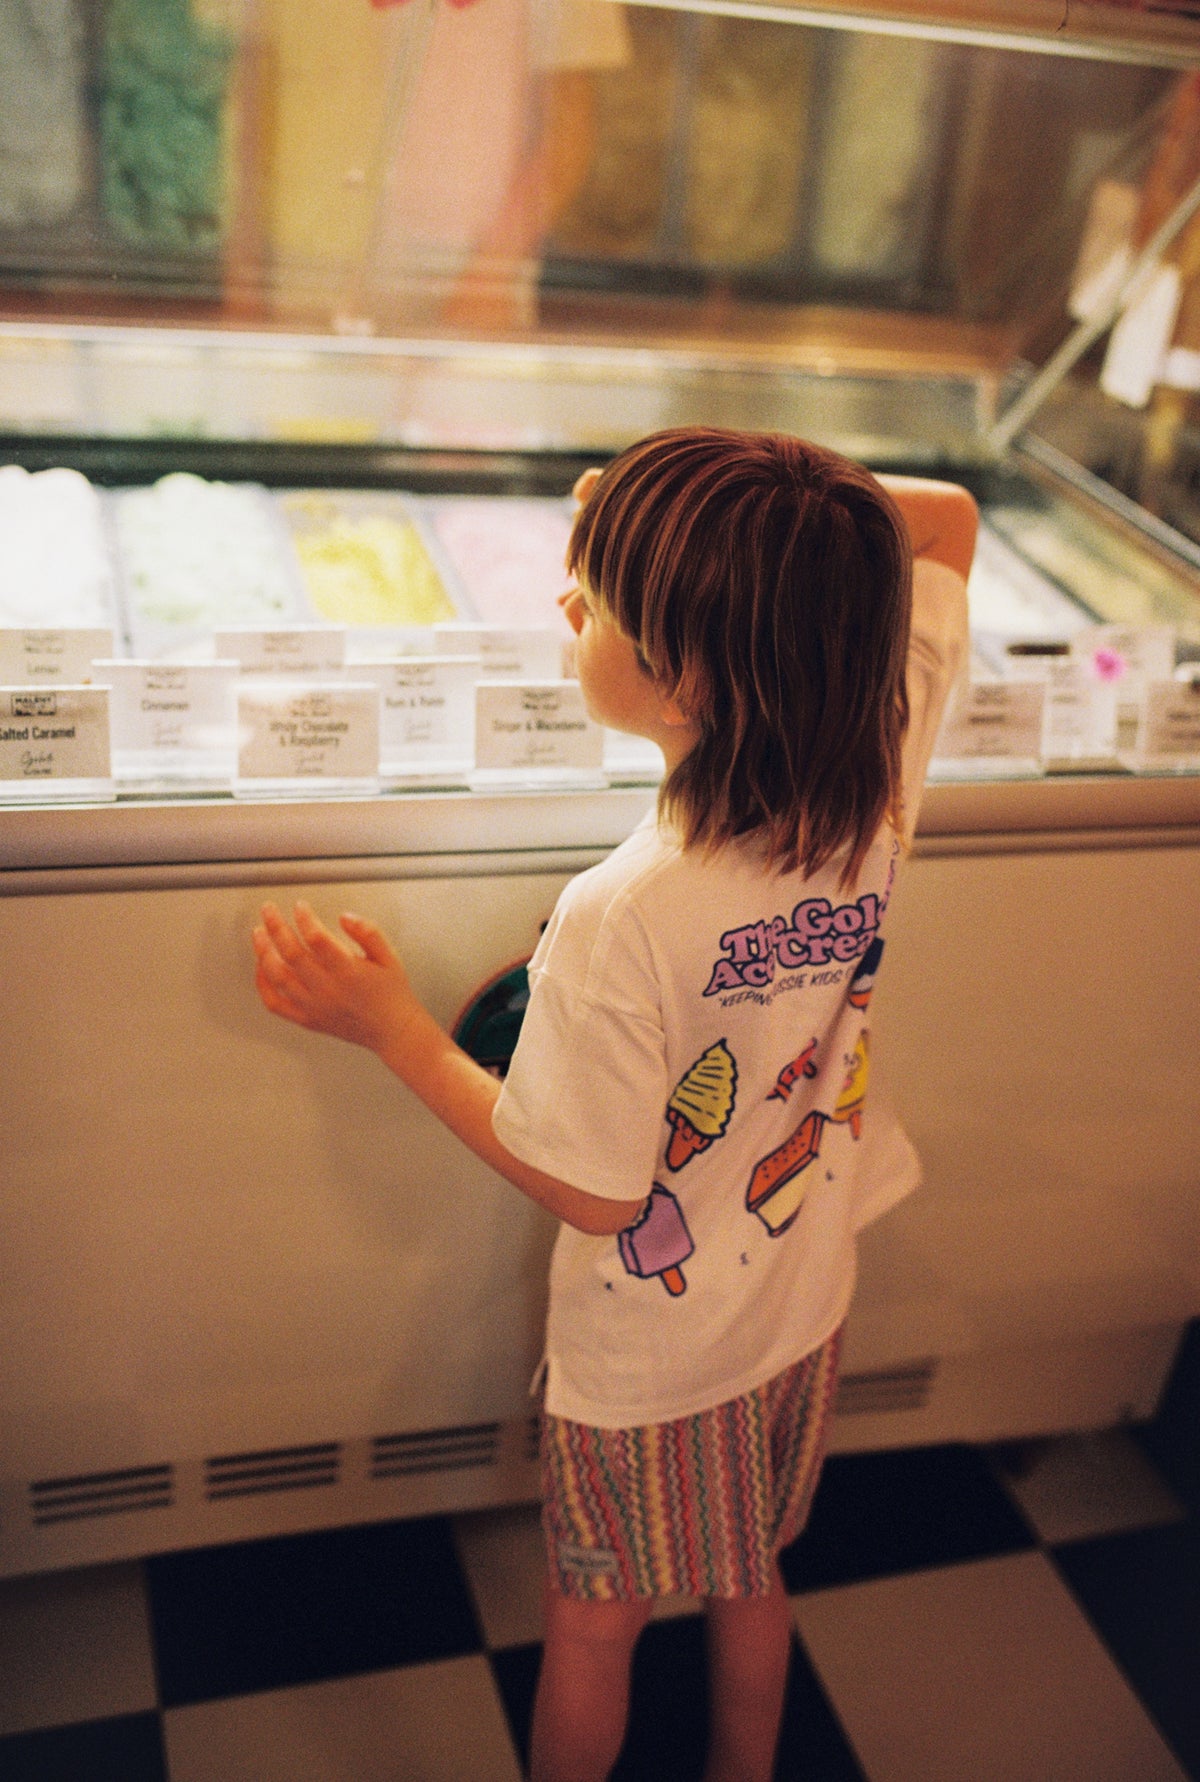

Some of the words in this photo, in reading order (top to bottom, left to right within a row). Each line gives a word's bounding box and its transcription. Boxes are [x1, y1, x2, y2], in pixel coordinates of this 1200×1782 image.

[32, 725, 76, 741] Caramel
[302, 720, 349, 733] Chocolate
[719, 915, 787, 964] The
[792, 892, 887, 937] Gol
[810, 969, 844, 986] KIDS
